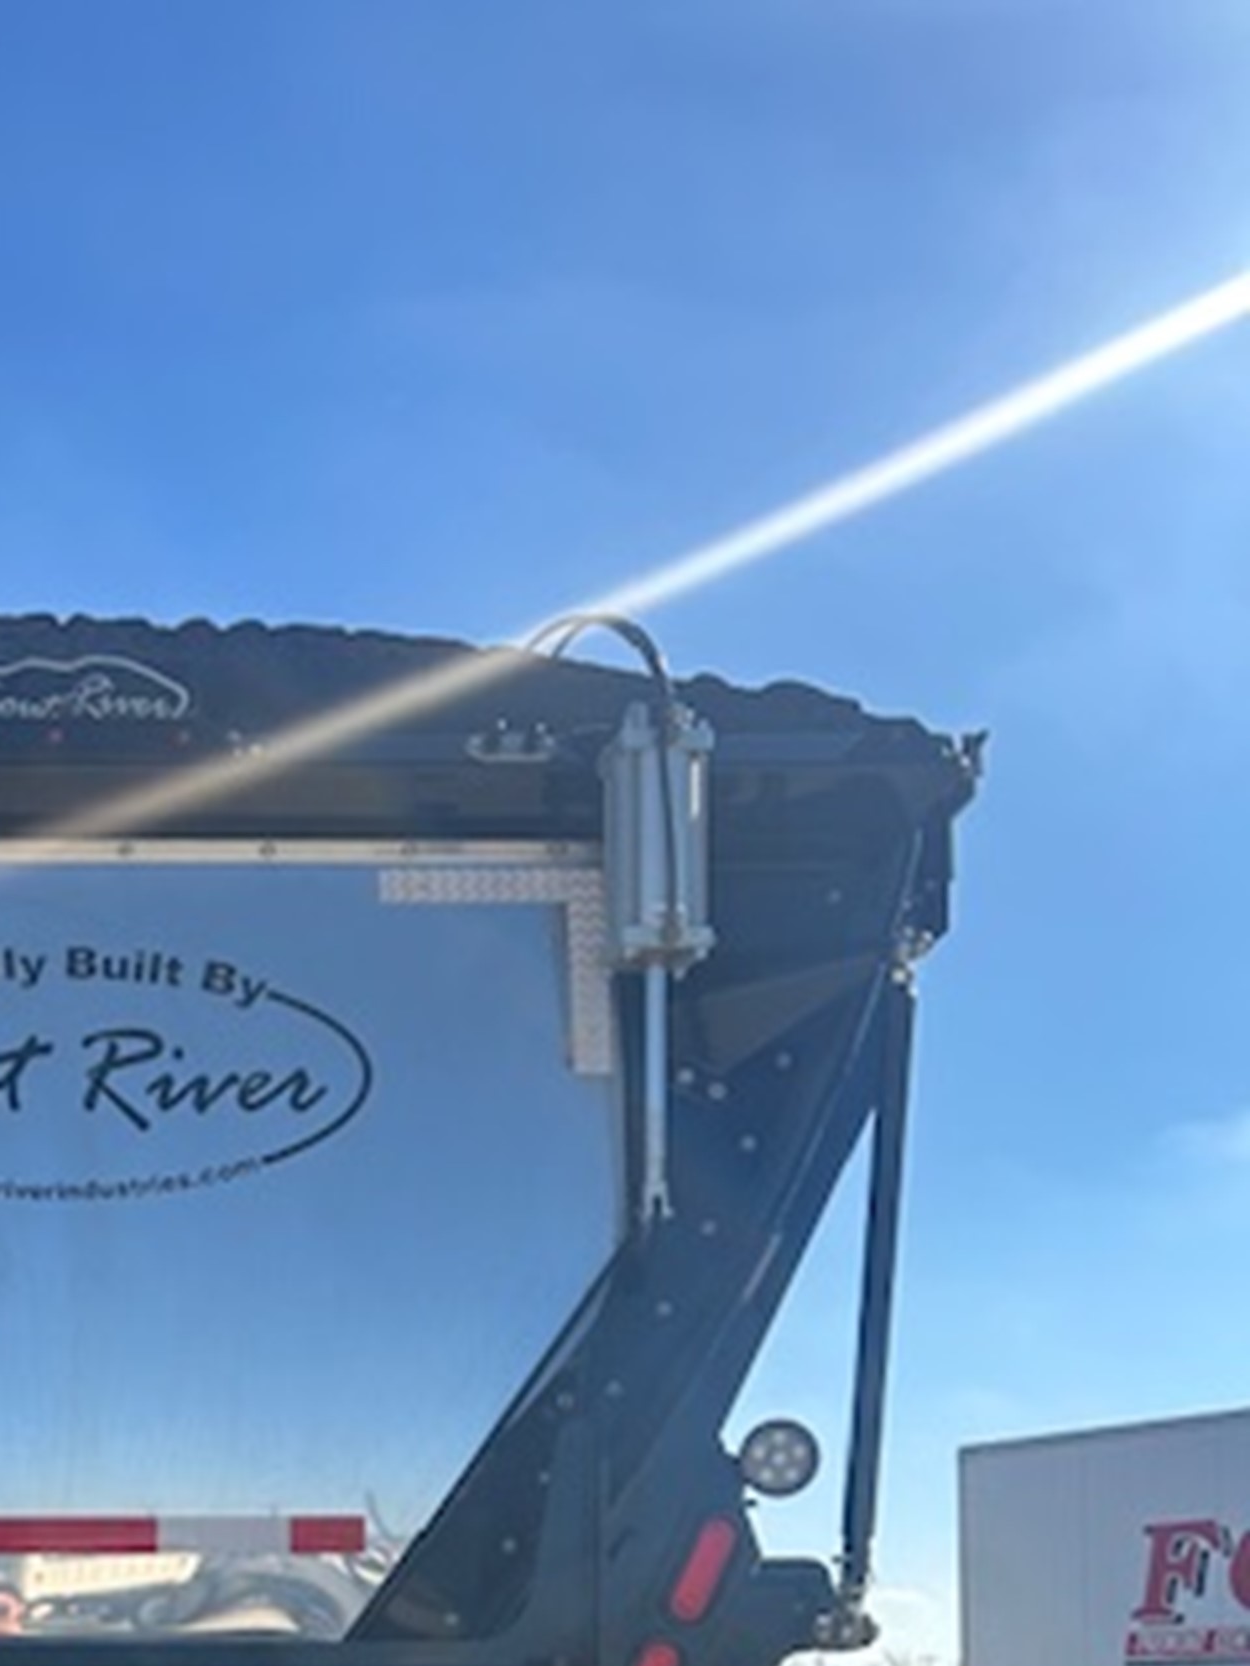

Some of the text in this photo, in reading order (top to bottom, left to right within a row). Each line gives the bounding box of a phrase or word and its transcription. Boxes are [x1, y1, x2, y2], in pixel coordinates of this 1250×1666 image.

[65, 946, 184, 988] Built
[201, 961, 271, 1010] By
[81, 1027, 327, 1131] River
[1129, 1518, 1250, 1625] F
